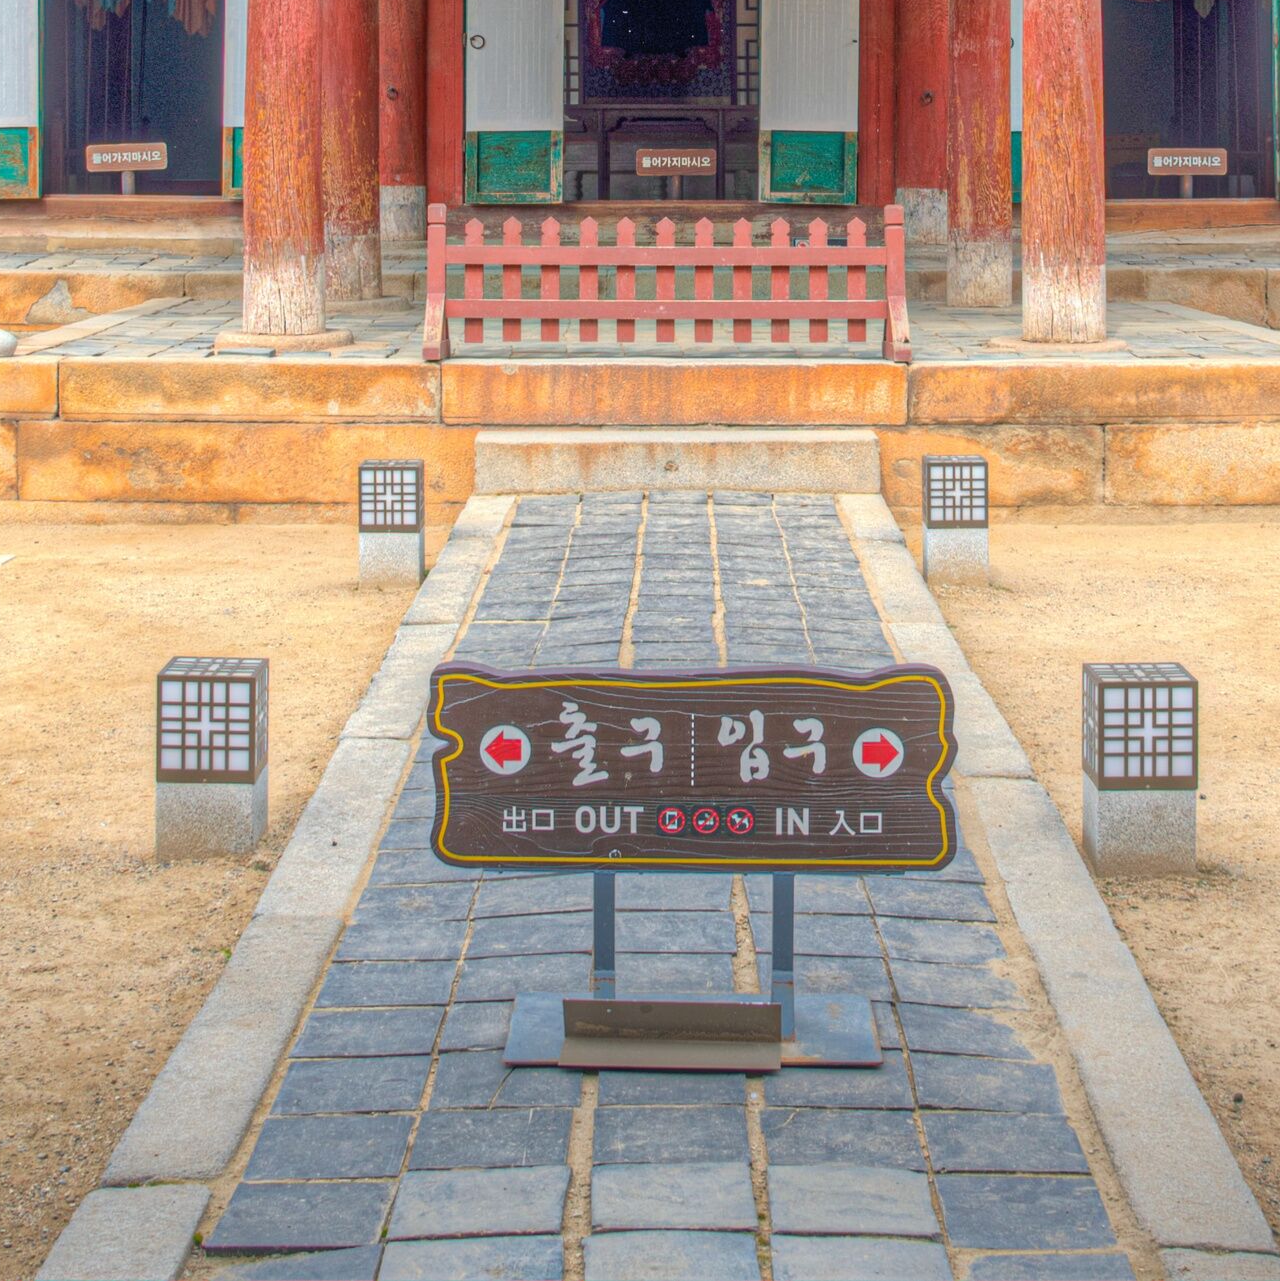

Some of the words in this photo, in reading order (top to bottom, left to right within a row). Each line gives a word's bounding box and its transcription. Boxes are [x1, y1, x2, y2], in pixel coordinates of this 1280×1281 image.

[551, 702, 664, 786] 출구
[718, 709, 827, 783] 입구
[502, 806, 555, 833] 出口
[575, 806, 644, 835] OUT
[775, 807, 810, 836] IN
[828, 810, 883, 836] 入口
